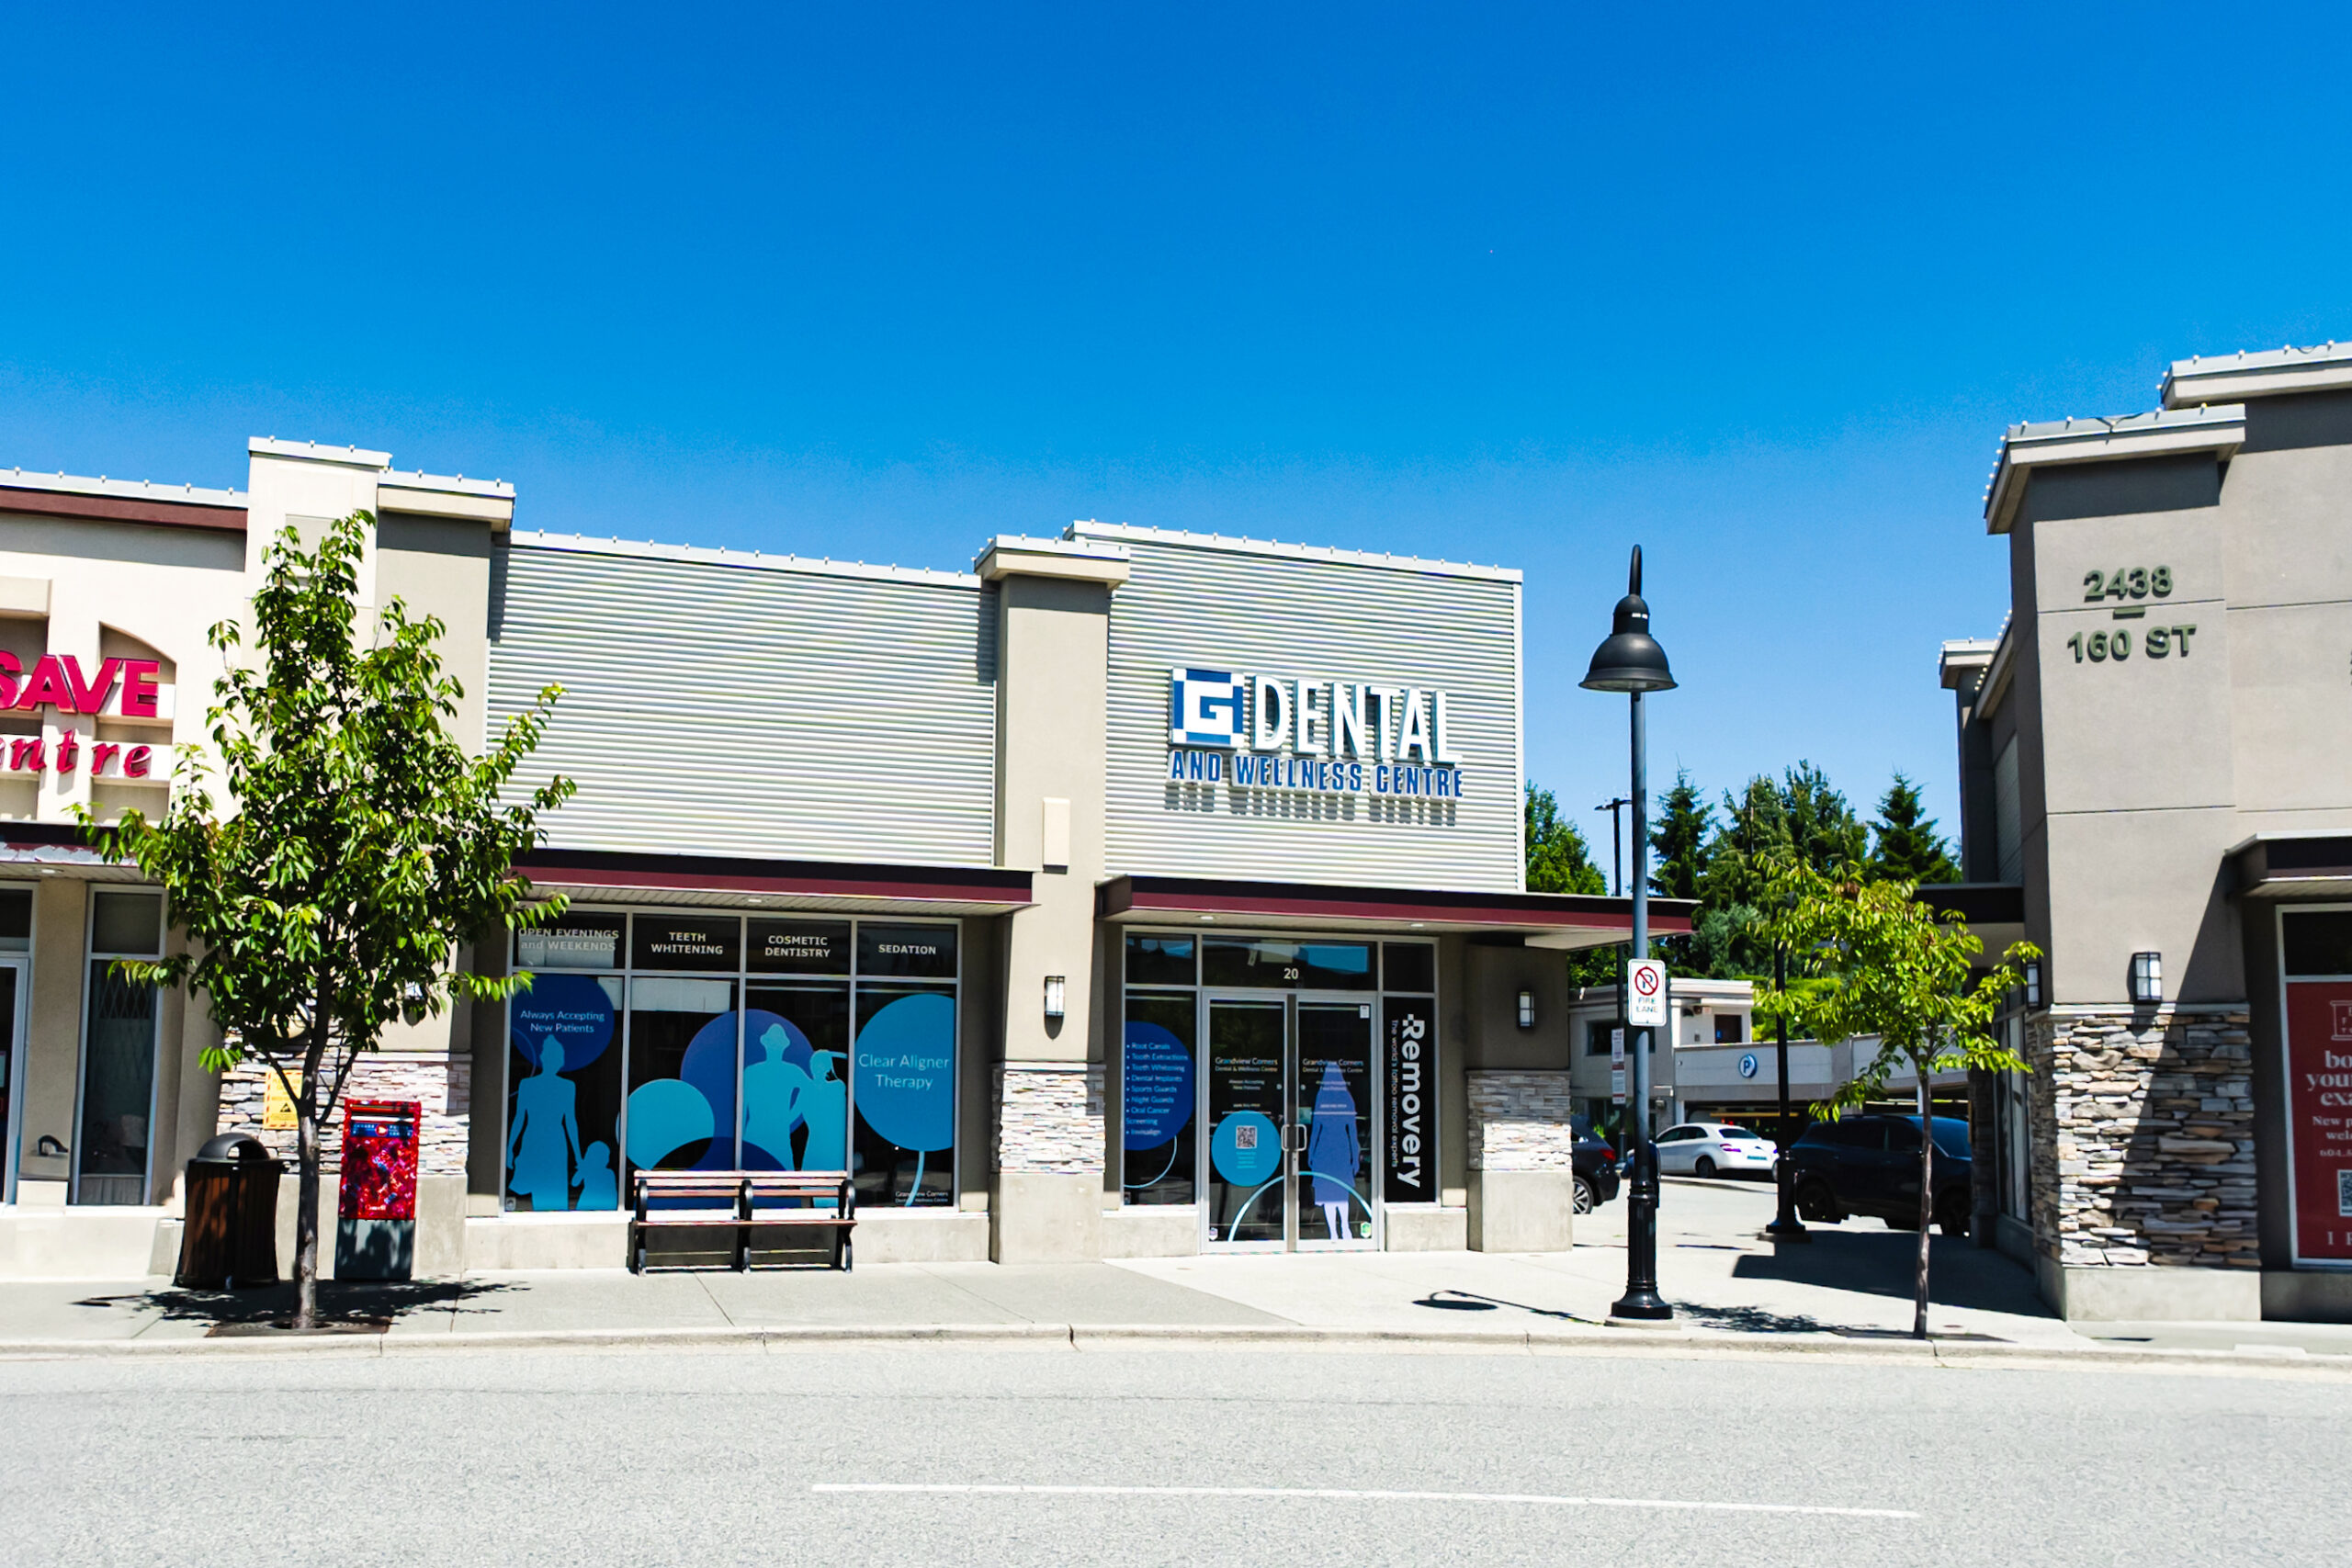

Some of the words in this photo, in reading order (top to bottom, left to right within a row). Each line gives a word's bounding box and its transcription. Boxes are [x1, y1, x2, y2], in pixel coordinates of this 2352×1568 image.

[2083, 564, 2174, 603] 2438
[2067, 629, 2132, 663] 160
[2145, 624, 2197, 659] ST
[1250, 674, 1463, 764] DENTAL
[0, 729, 153, 778] ntre
[1170, 750, 1222, 782] AND
[1233, 755, 1363, 793] WELLNESS
[1374, 764, 1464, 797] CENTRE
[517, 927, 552, 938] OPEN
[556, 928, 619, 939] EVENINGS
[668, 931, 707, 942] TEETH
[521, 940, 544, 950] and
[548, 941, 616, 952] WEEKENDS
[768, 935, 828, 946] COSMETIC
[650, 943, 724, 954] WHITENING
[764, 947, 831, 958] DENTISTRY
[878, 944, 937, 954] SEDATION
[1283, 967, 1299, 980] 20
[1638, 997, 1657, 1005] FIRE
[520, 1010, 555, 1021] Always
[557, 1010, 605, 1022] Accepting
[530, 1022, 553, 1032] New
[555, 1022, 595, 1033] Patients
[858, 1054, 897, 1068] Clear
[899, 1054, 950, 1071] Aligner
[875, 1074, 933, 1090] Therapy
[2306, 1074, 2352, 1091] you
[1397, 1014, 1425, 1188] Removery
[2312, 1115, 2341, 1126] New
